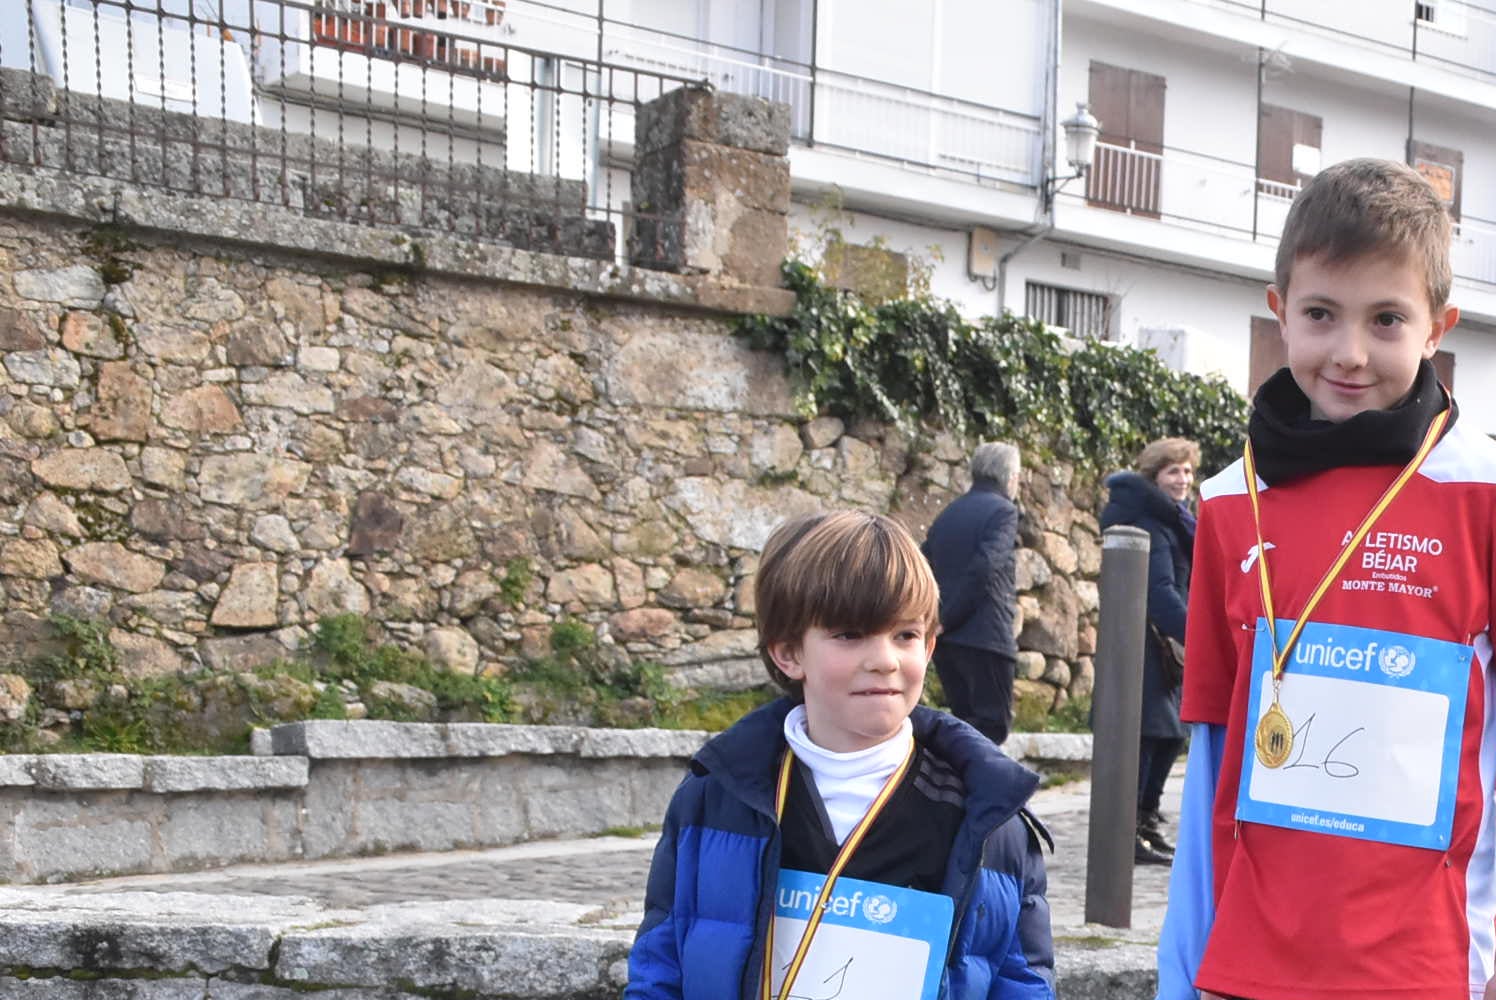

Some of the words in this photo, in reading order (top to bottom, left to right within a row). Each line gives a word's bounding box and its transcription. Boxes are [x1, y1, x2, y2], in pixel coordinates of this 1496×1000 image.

[1341, 530, 1443, 556] ALETISMO
[1362, 549, 1418, 573] BÉJAR
[1342, 580, 1385, 592] MONTE
[1295, 637, 1378, 672] unicef
[1283, 712, 1365, 779] 16
[1290, 812, 1366, 833] unicef.es/educa
